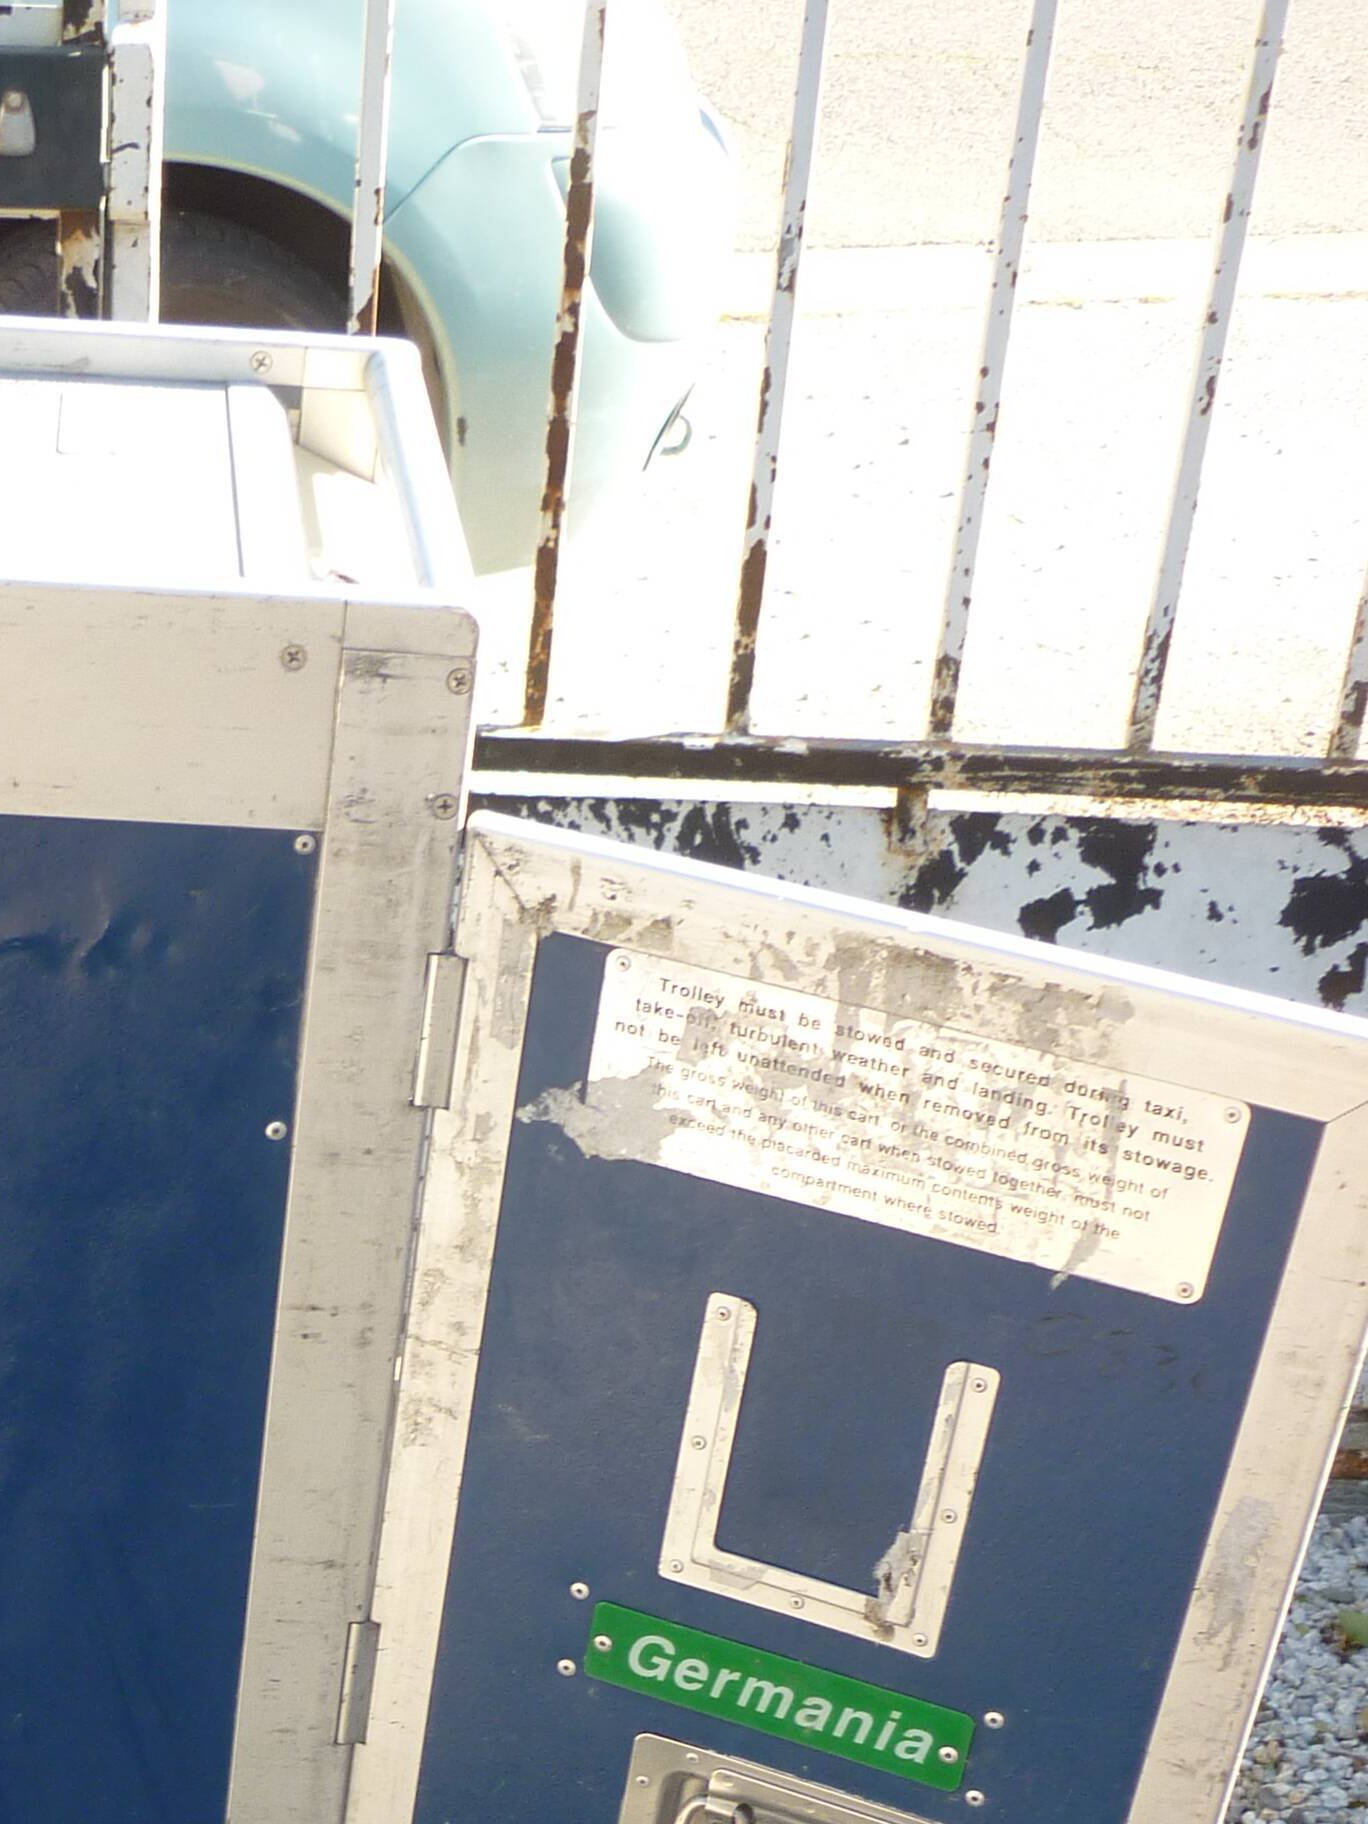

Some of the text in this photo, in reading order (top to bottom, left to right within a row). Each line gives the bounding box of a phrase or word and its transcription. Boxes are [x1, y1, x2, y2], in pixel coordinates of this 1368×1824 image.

[615, 1018, 1214, 1183] not be left unattended when removed from its stowage.
[659, 977, 725, 1008] Trolley
[738, 999, 786, 1022] must
[798, 1012, 822, 1031] be
[835, 1023, 906, 1052] stowed
[918, 1043, 955, 1064] and
[969, 1058, 1052, 1088] secured
[1144, 1099, 1189, 1125] taxi,
[832, 1048, 910, 1078] weather
[921, 1069, 960, 1091] and
[1152, 1129, 1206, 1153] must
[646, 1056, 674, 1074] The
[681, 1063, 726, 1088] gross
[732, 1079, 785, 1102] weight
[792, 1093, 808, 1107] of
[814, 1096, 842, 1117] this
[847, 1108, 880, 1127] cart
[890, 1120, 907, 1134] or
[913, 1123, 939, 1143] the
[1032, 1153, 1080, 1179] gross
[1087, 1171, 1144, 1199] weight
[1150, 1185, 1170, 1200] of
[651, 1083, 1151, 1223] this cart and any other cart when stowed together must not
[669, 1111, 1121, 1241] exceed the placarded maximum contents weight of the
[771, 1165, 880, 1201] compartment
[884, 1194, 932, 1217] where
[627, 1634, 934, 1765] Germania
